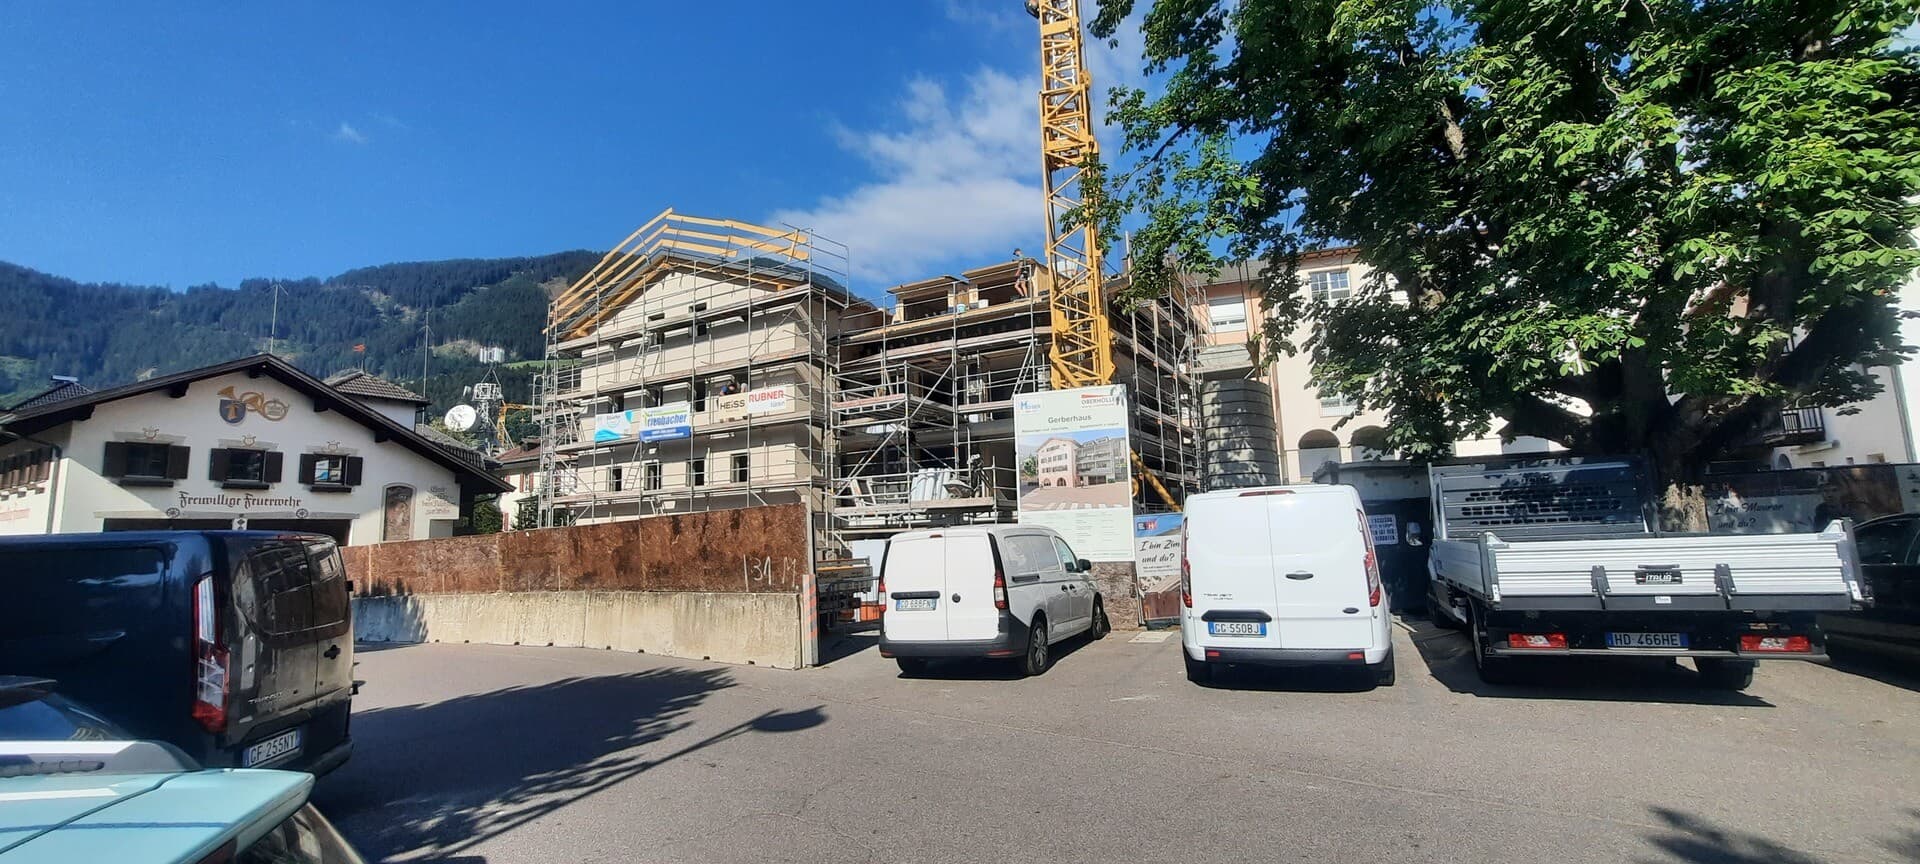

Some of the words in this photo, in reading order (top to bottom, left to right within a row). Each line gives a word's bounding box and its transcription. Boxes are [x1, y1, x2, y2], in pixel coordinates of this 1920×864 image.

[749, 390, 784, 403] RUBNER
[1048, 415, 1092, 424] Gerberhaus
[178, 490, 241, 508] Freiwillige
[243, 492, 302, 509] Feuerwehr
[1149, 541, 1162, 550] bin
[1141, 554, 1157, 563] und
[1159, 552, 1175, 562] du?
[1229, 623, 1260, 634] 550BJ
[1614, 633, 1631, 646] HD
[1637, 633, 1679, 646] 466HE
